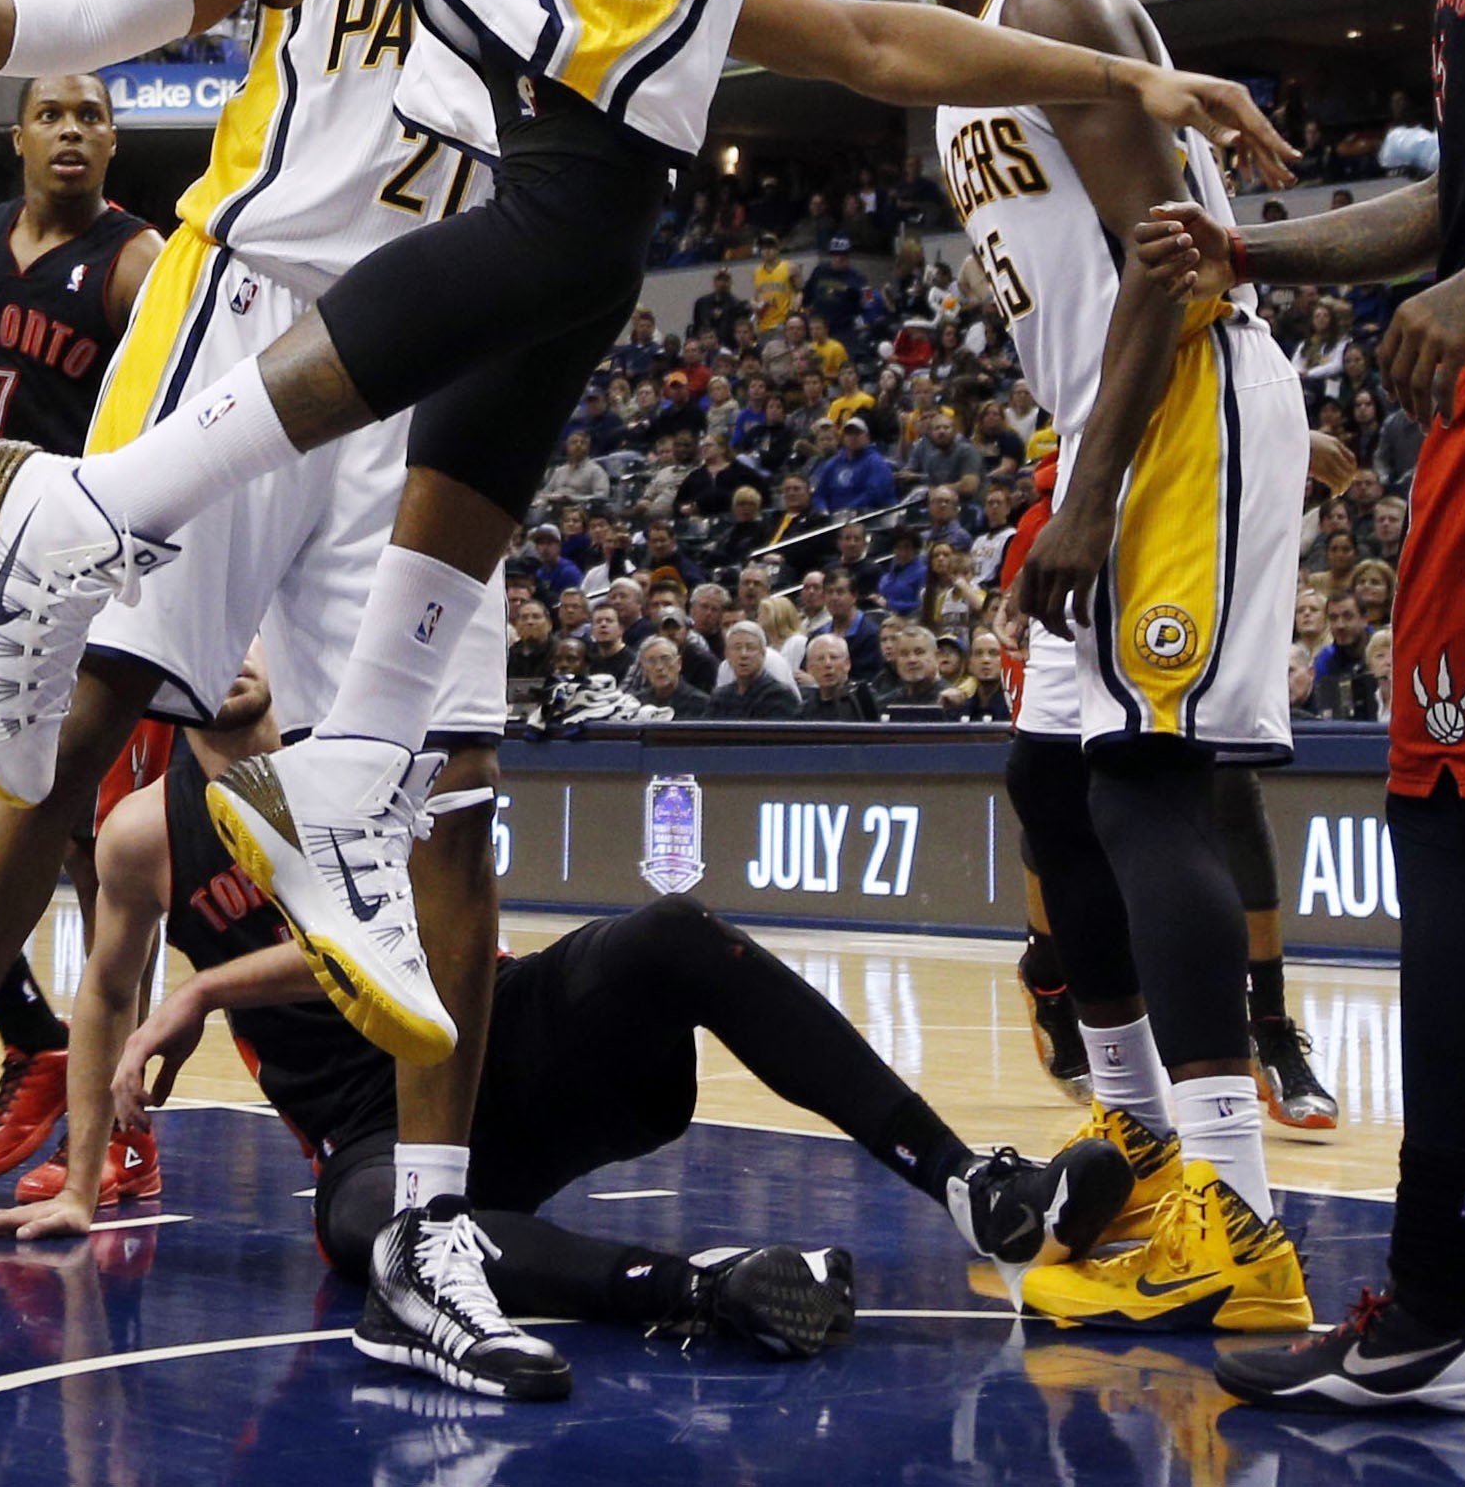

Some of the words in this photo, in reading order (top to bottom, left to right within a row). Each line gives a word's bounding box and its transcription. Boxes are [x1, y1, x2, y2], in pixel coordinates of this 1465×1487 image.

[117, 77, 192, 110] Lake
[747, 801, 849, 893] JULY
[861, 805, 921, 897] 27
